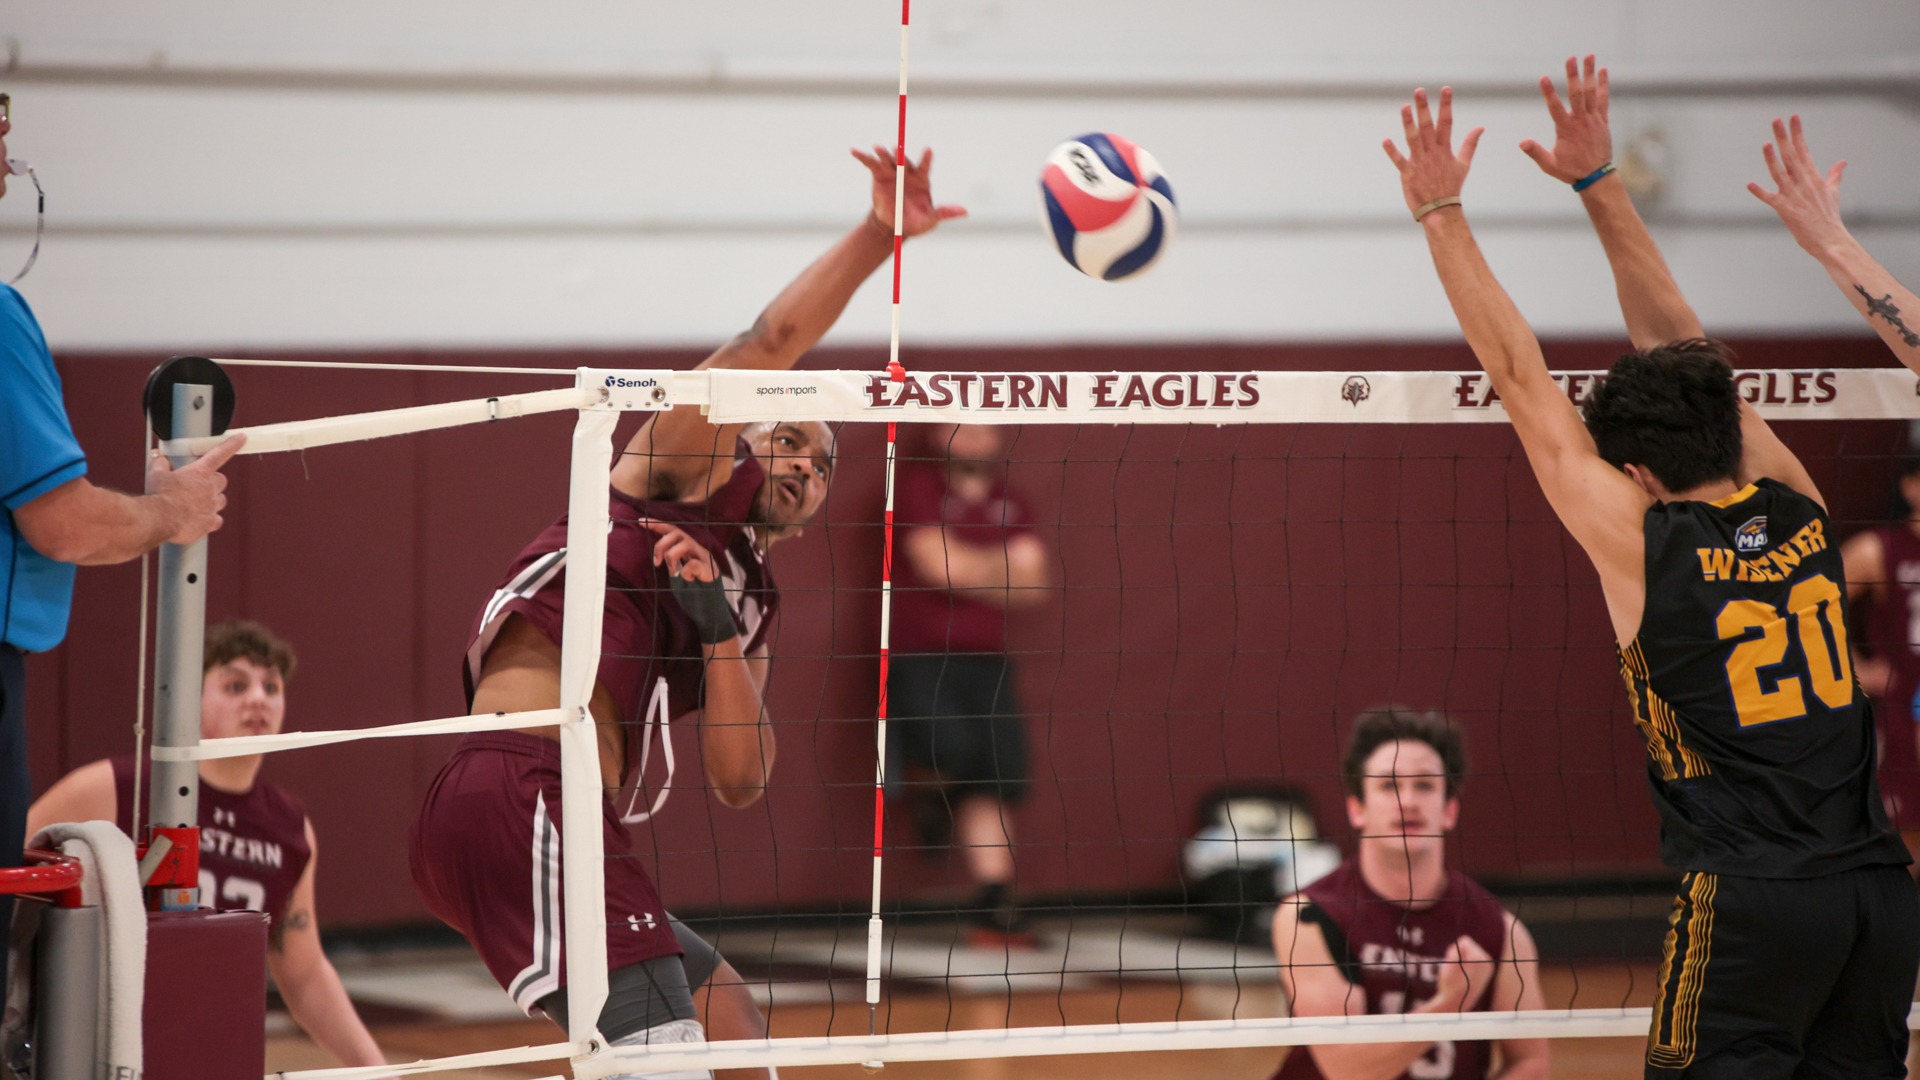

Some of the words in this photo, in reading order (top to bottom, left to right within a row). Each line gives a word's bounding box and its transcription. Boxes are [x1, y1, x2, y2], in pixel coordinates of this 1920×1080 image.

[617, 377, 657, 388] Senoh
[756, 386, 785, 396] sports
[864, 373, 1068, 410] EASTERN
[1090, 373, 1260, 410] EAGLES
[1734, 371, 1838, 406] GLES
[1715, 571, 1853, 730] 20
[199, 826, 282, 869] STERN
